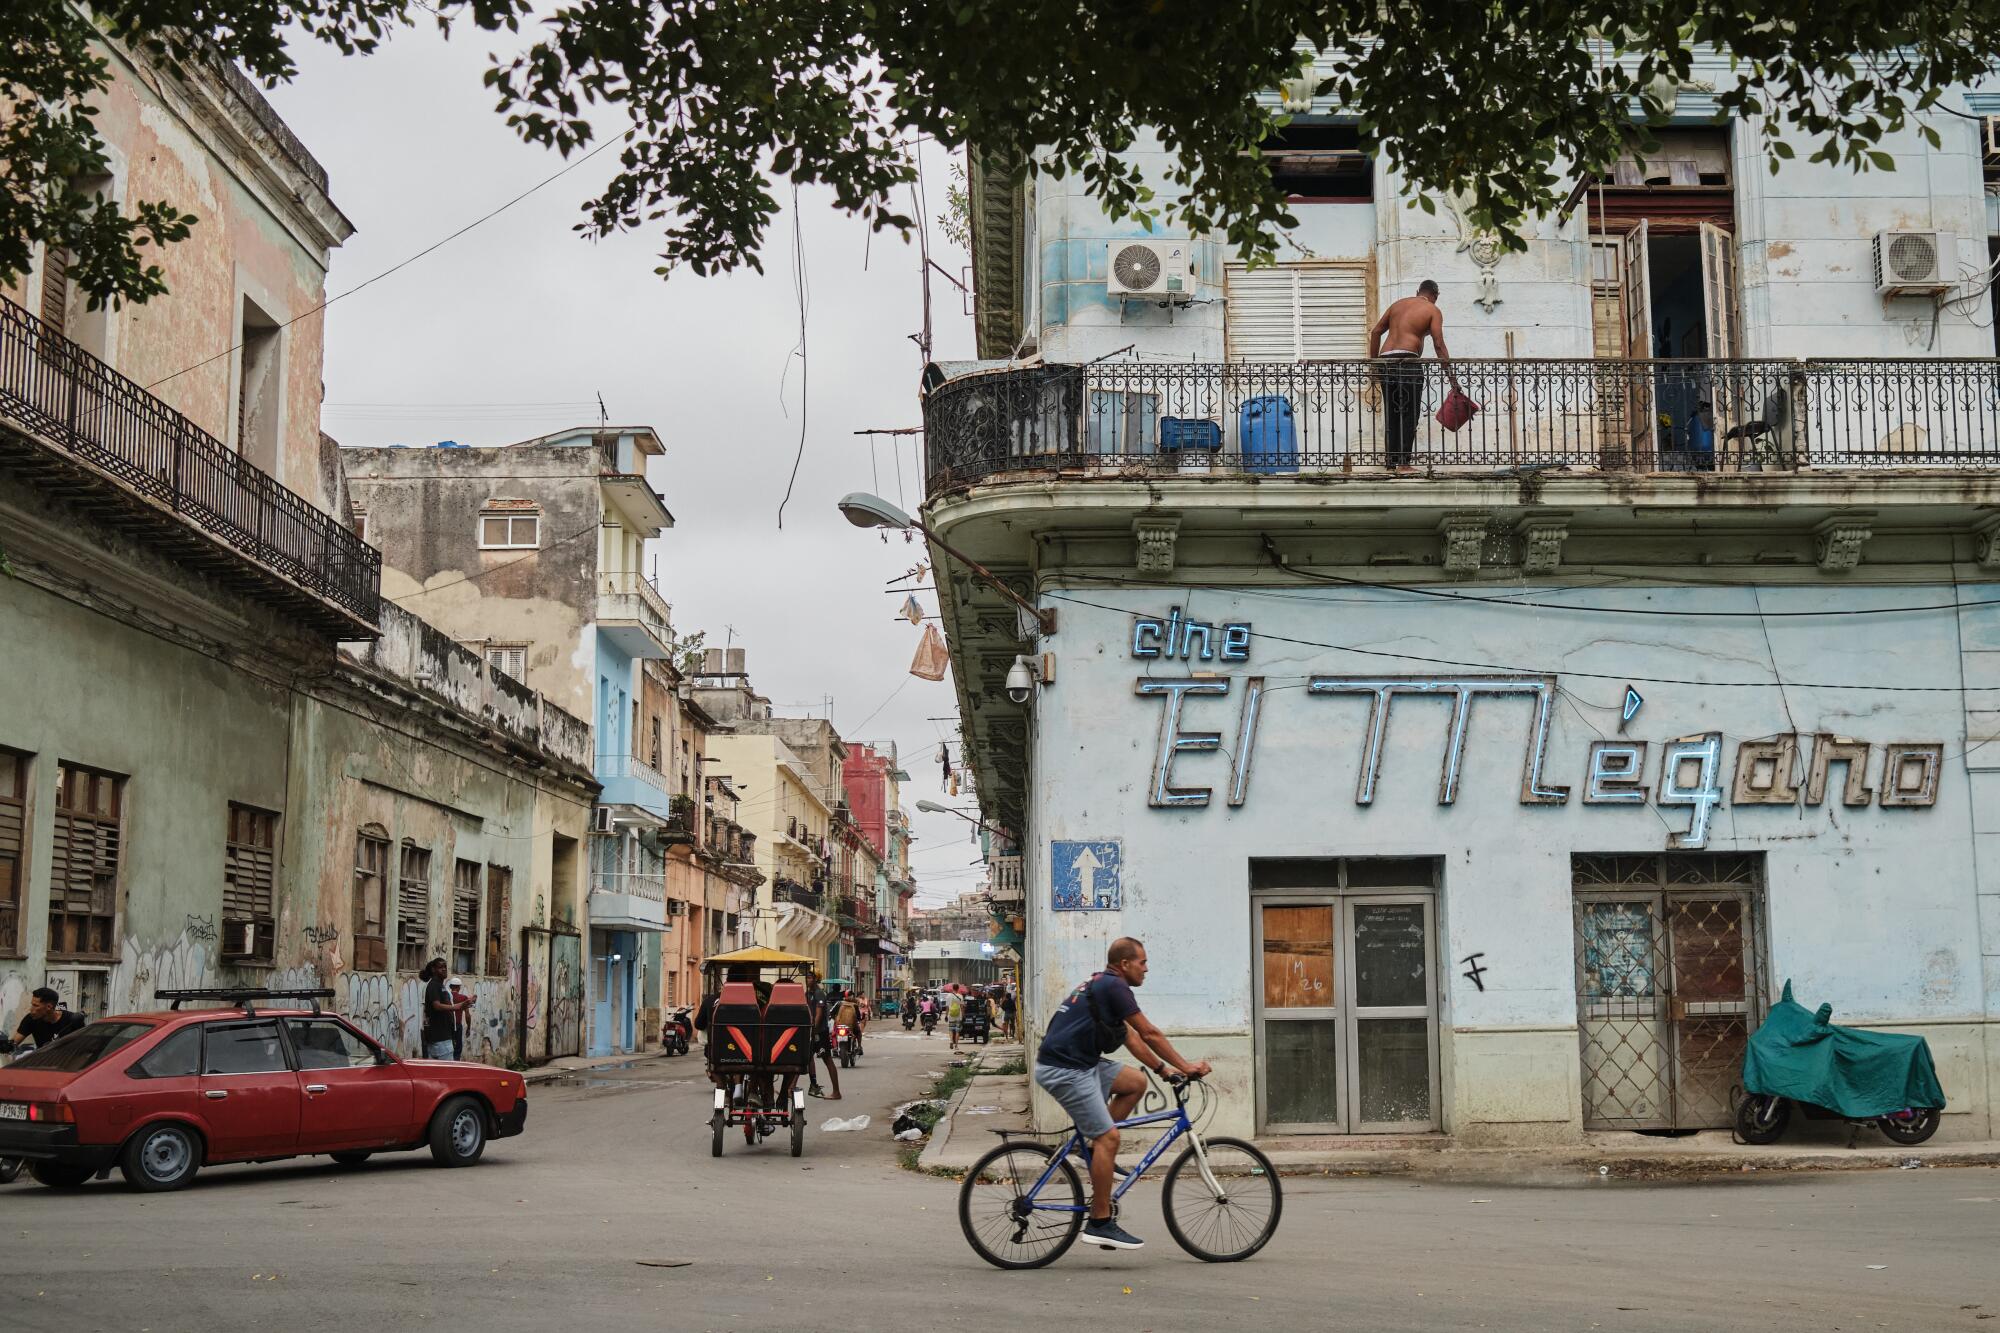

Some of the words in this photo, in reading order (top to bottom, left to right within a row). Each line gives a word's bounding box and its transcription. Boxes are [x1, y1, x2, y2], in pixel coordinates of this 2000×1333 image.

[1131, 605, 1252, 662] cine
[1135, 675, 1265, 808] El
[1303, 976, 1323, 991] 26
